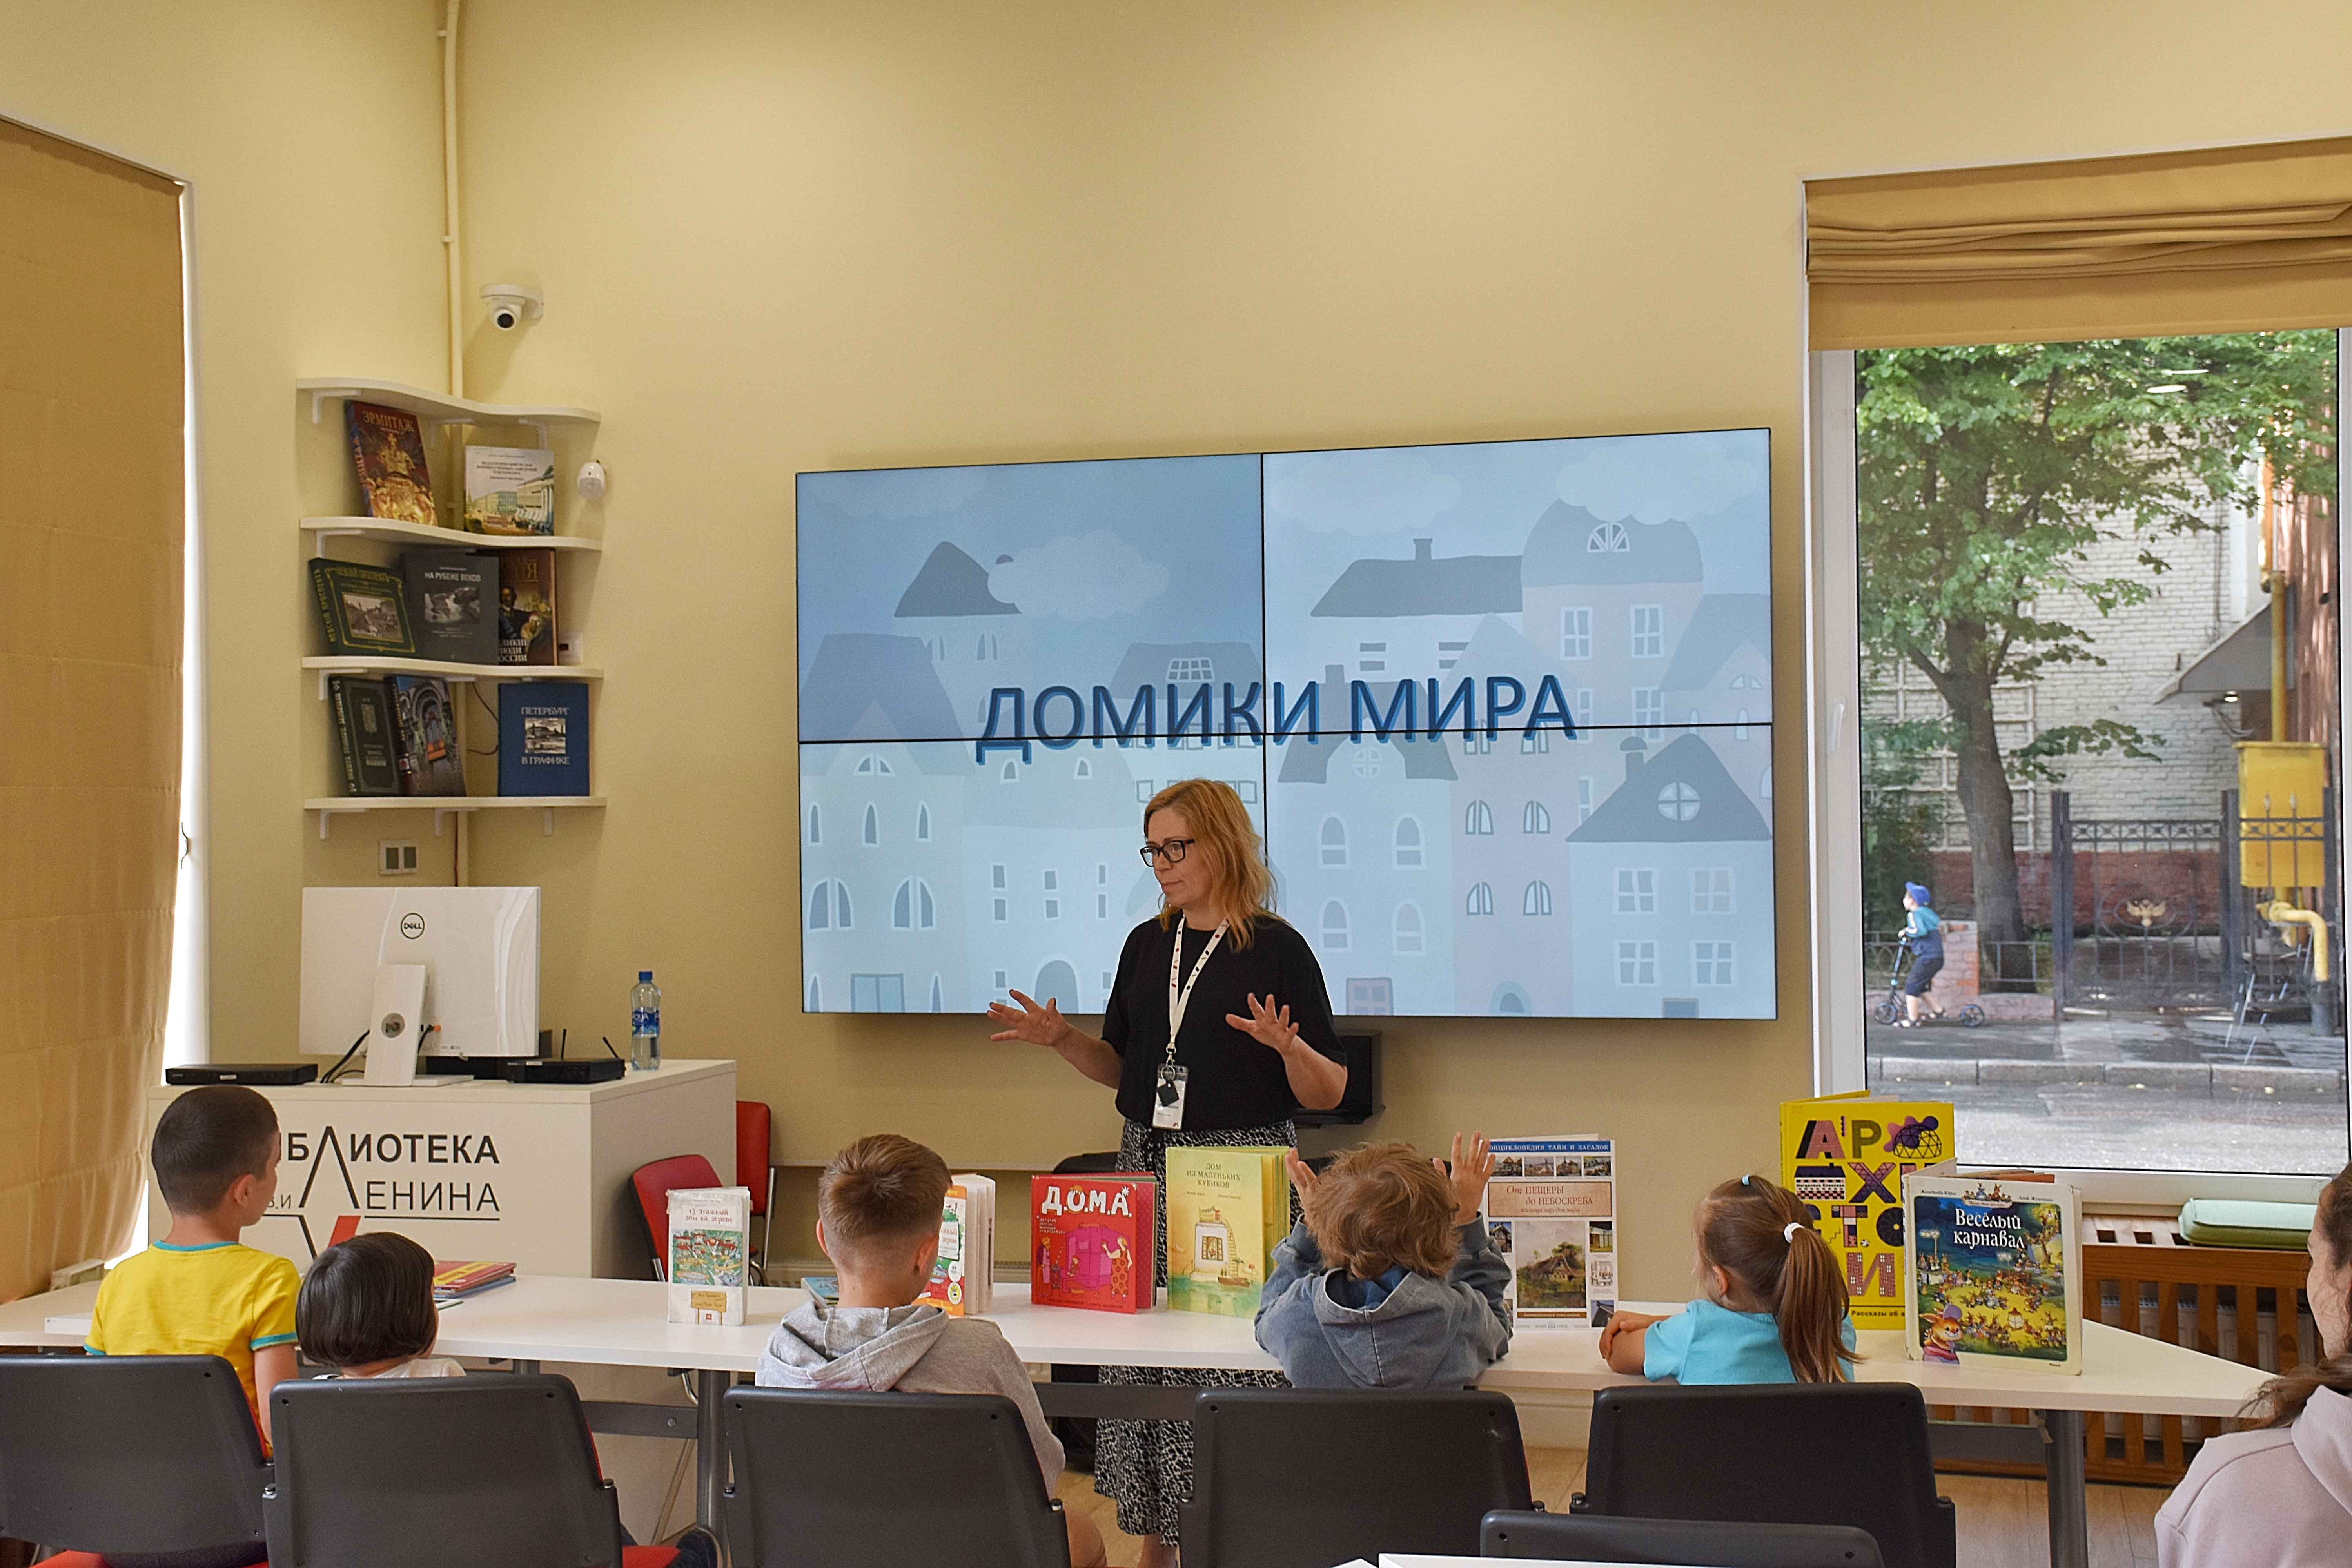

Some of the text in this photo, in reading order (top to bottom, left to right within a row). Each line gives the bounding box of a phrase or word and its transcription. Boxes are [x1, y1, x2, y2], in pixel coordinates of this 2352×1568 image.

[363, 411, 415, 432] ЭРМИТАЖ
[436, 572, 459, 581] РУБЕЖЕ
[461, 574, 481, 582] ВЕКОВ
[521, 707, 570, 715] ПЕТЕРБУРГ
[976, 674, 1577, 764] ДОМИКИ МИРА
[1198, 1171, 1240, 1181] МАЛЕНЬКИХ
[1198, 1180, 1229, 1188] КУБИКОВ
[1507, 1185, 1564, 1195] От ПЕЩЕРЫ
[1955, 1208, 2022, 1230] Весёлый
[1954, 1230, 2026, 1249] карнавал
